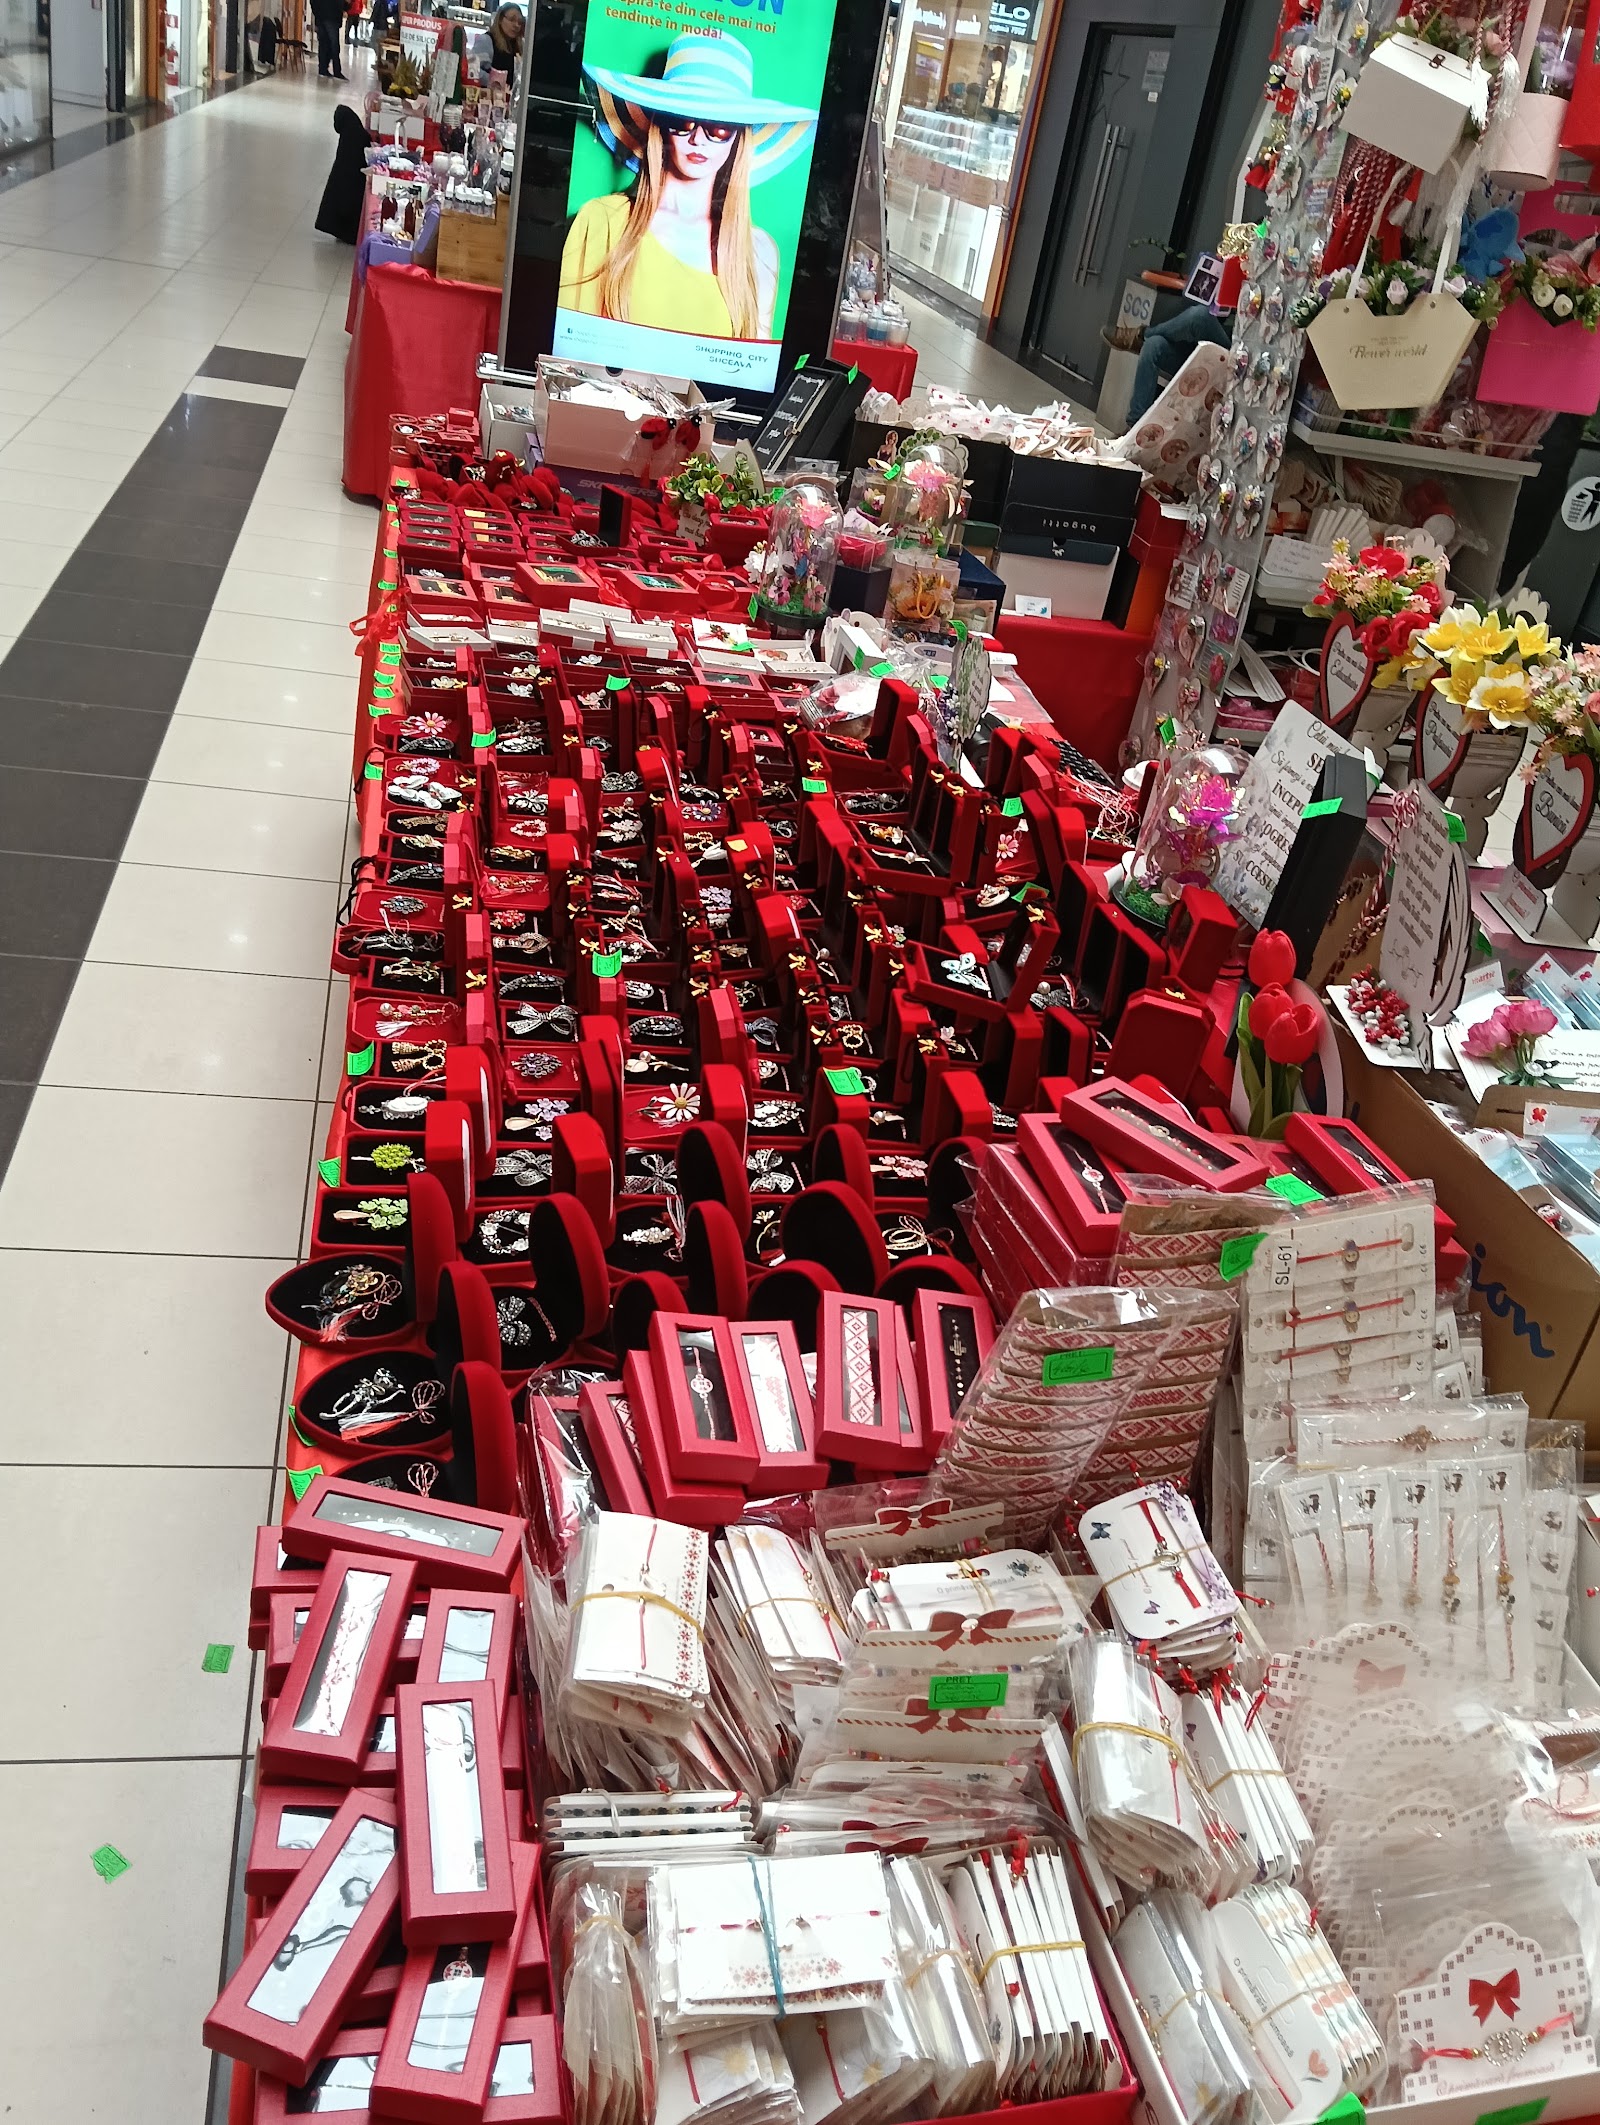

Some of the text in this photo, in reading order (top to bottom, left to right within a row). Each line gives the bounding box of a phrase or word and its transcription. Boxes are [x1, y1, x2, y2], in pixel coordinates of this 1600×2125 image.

[413, 17, 442, 30] PRODUS
[605, 6, 723, 40] tendințe în modă!
[675, 3, 696, 17] din
[699, 9, 726, 23] cele
[728, 15, 751, 29] mai
[755, 22, 777, 34] noi
[1123, 293, 1151, 320] SCS
[696, 344, 768, 364] SHOPPING CITY
[577, 479, 658, 497] SKHERS
[1042, 519, 1096, 533] bugatti
[1272, 779, 1305, 817] ÎNCEPU
[1273, 1244, 1293, 1287] SL-61
[1233, 1957, 1294, 2059] O primăvară rumoasă
